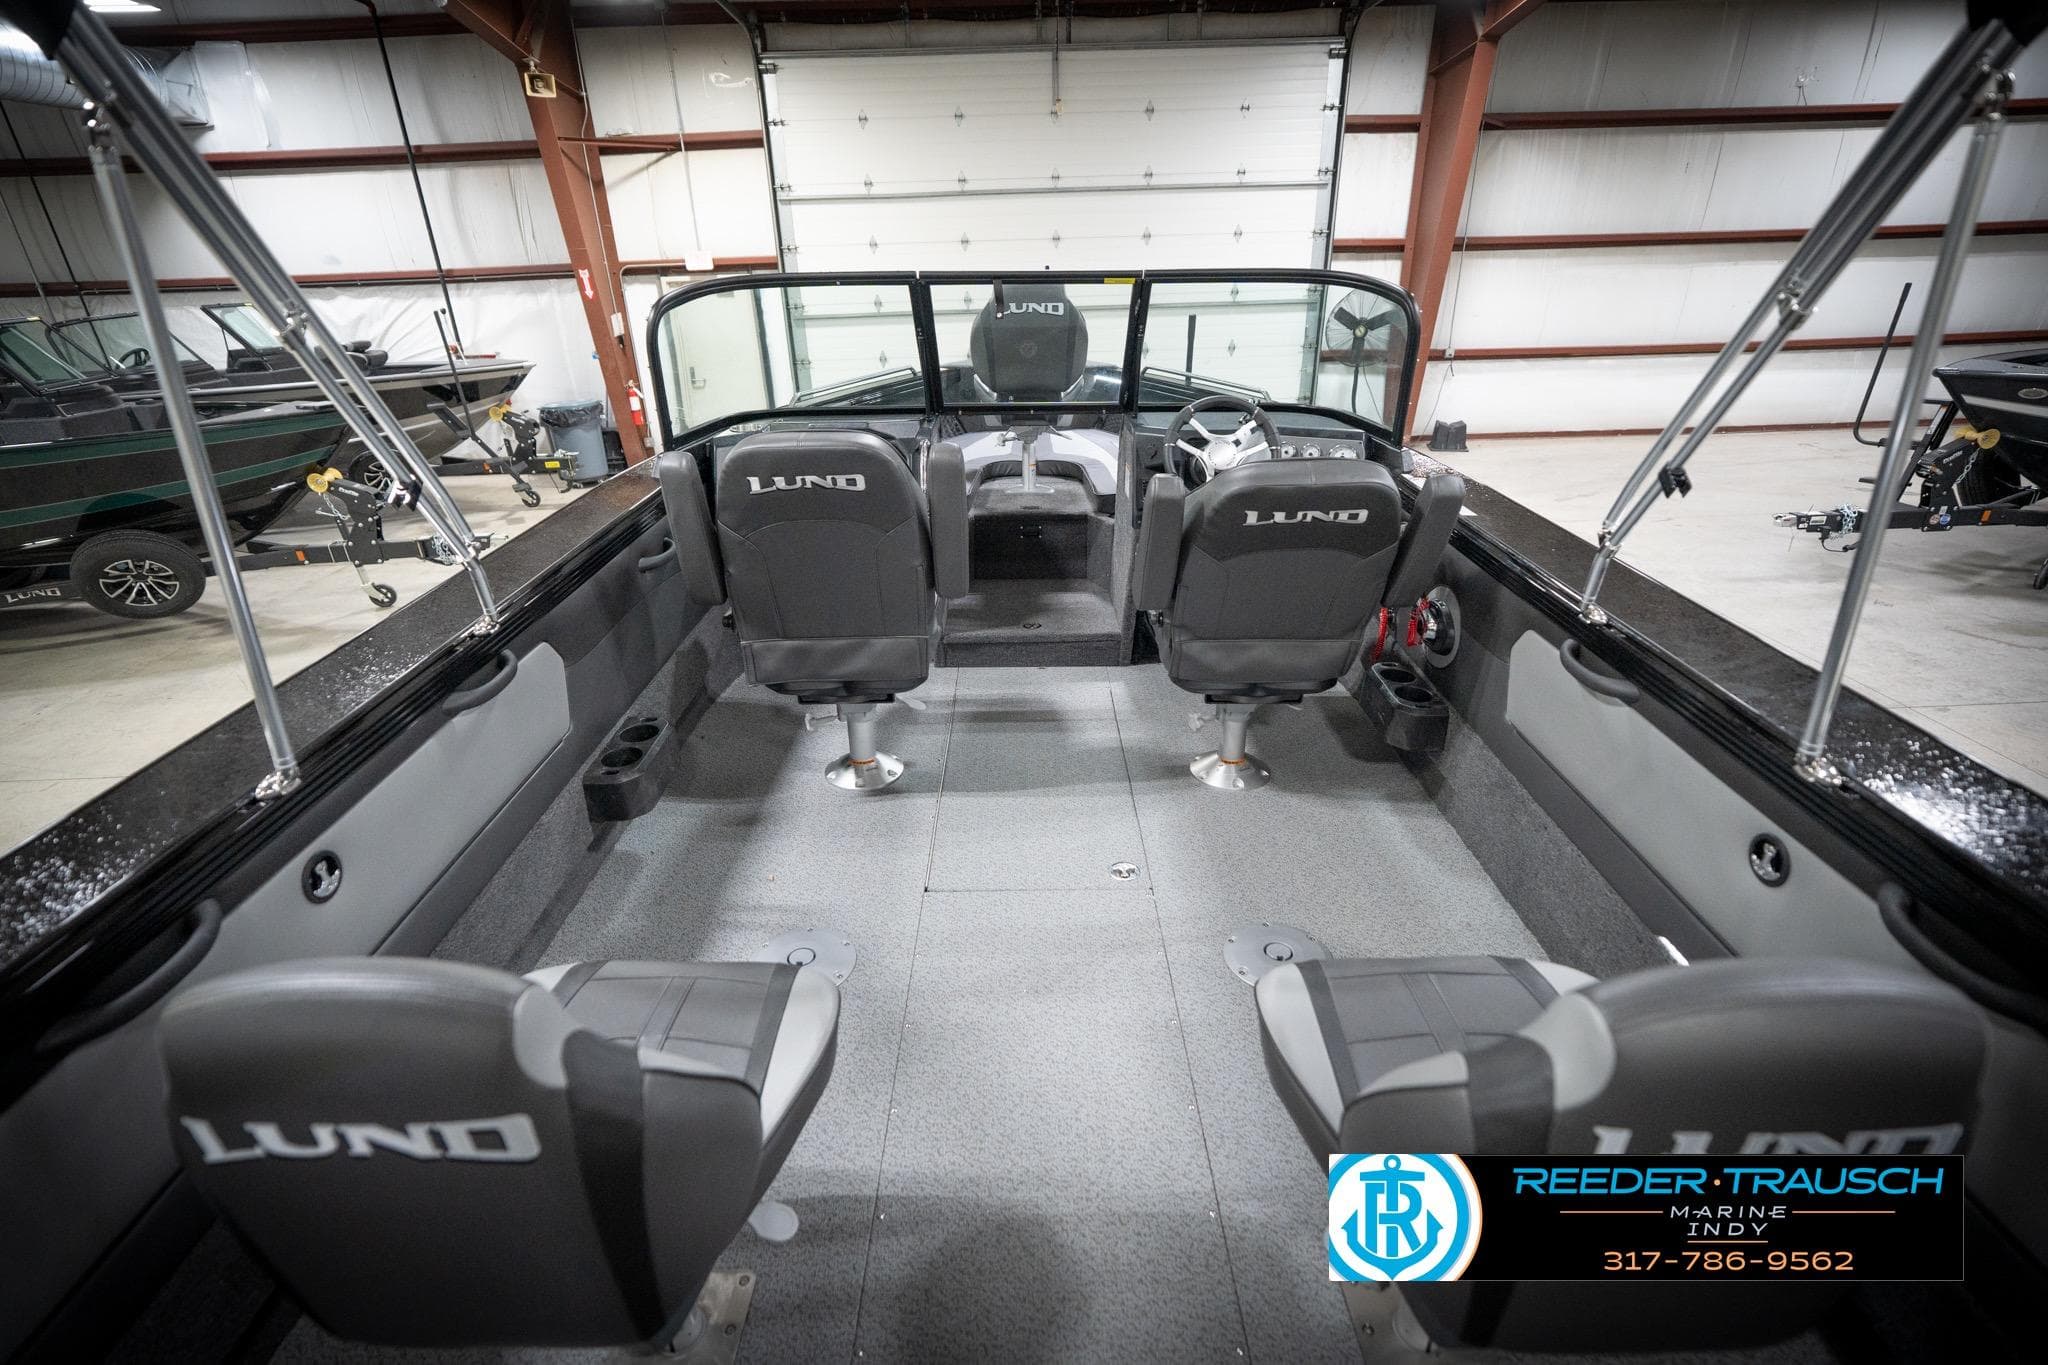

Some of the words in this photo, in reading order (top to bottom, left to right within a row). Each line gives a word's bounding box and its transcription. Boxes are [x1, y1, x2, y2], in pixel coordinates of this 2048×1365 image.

[746, 474, 866, 495] LUND
[1243, 509, 1369, 526] LUND
[4, 587, 61, 604] LUND
[180, 1113, 541, 1165] LUND
